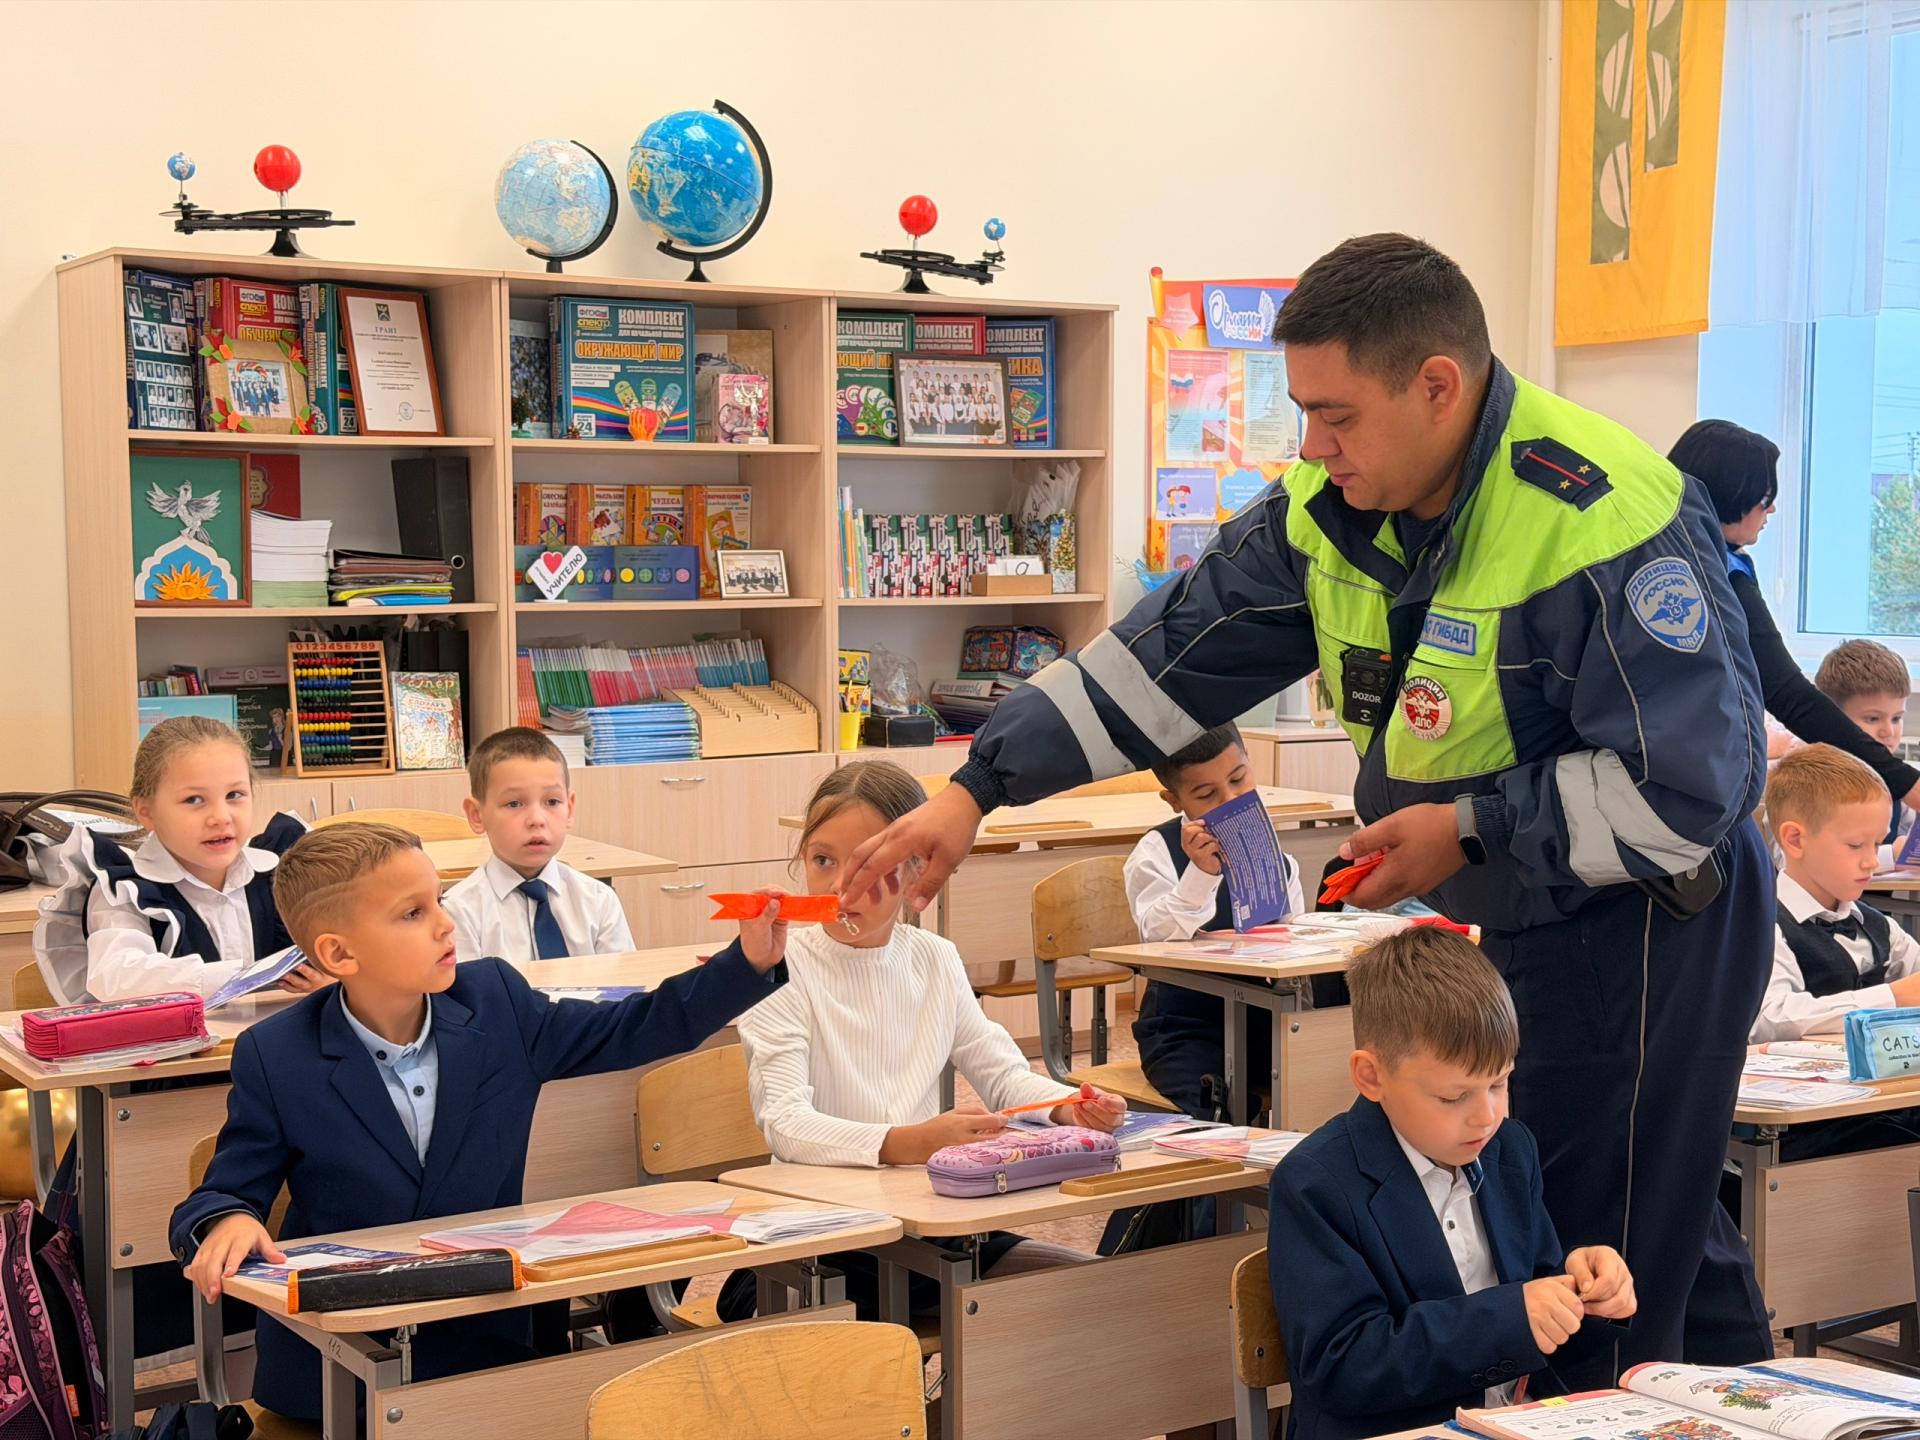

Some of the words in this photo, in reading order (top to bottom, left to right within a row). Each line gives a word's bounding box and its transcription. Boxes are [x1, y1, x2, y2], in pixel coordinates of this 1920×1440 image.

[618, 309, 684, 326] КОМПЛЕКТ
[1209, 291, 1262, 332] Орлята
[915, 324, 974, 338] ОМПЛЕКТ
[987, 328, 1044, 341] ОМПЛЕКТ
[577, 339, 657, 361] ОКРУЖАЮЩИЙ
[659, 344, 682, 360] МИР
[344, 417, 354, 426] 24
[578, 422, 593, 432] 24
[546, 553, 583, 595] УЧИТЕЛЮ
[1630, 563, 1690, 597] ПОЛИЦИЯ
[1643, 577, 1689, 606] РОССИЯ
[1432, 621, 1470, 646] ГИБДД
[1677, 629, 1702, 648] МВД
[1352, 691, 1382, 704] DOZOR
[1403, 677, 1446, 701] ПОЛИЦИЯ
[1415, 716, 1432, 729] ДПС
[1882, 1034, 1920, 1052] CATS
[328, 1336, 342, 1359] 112
